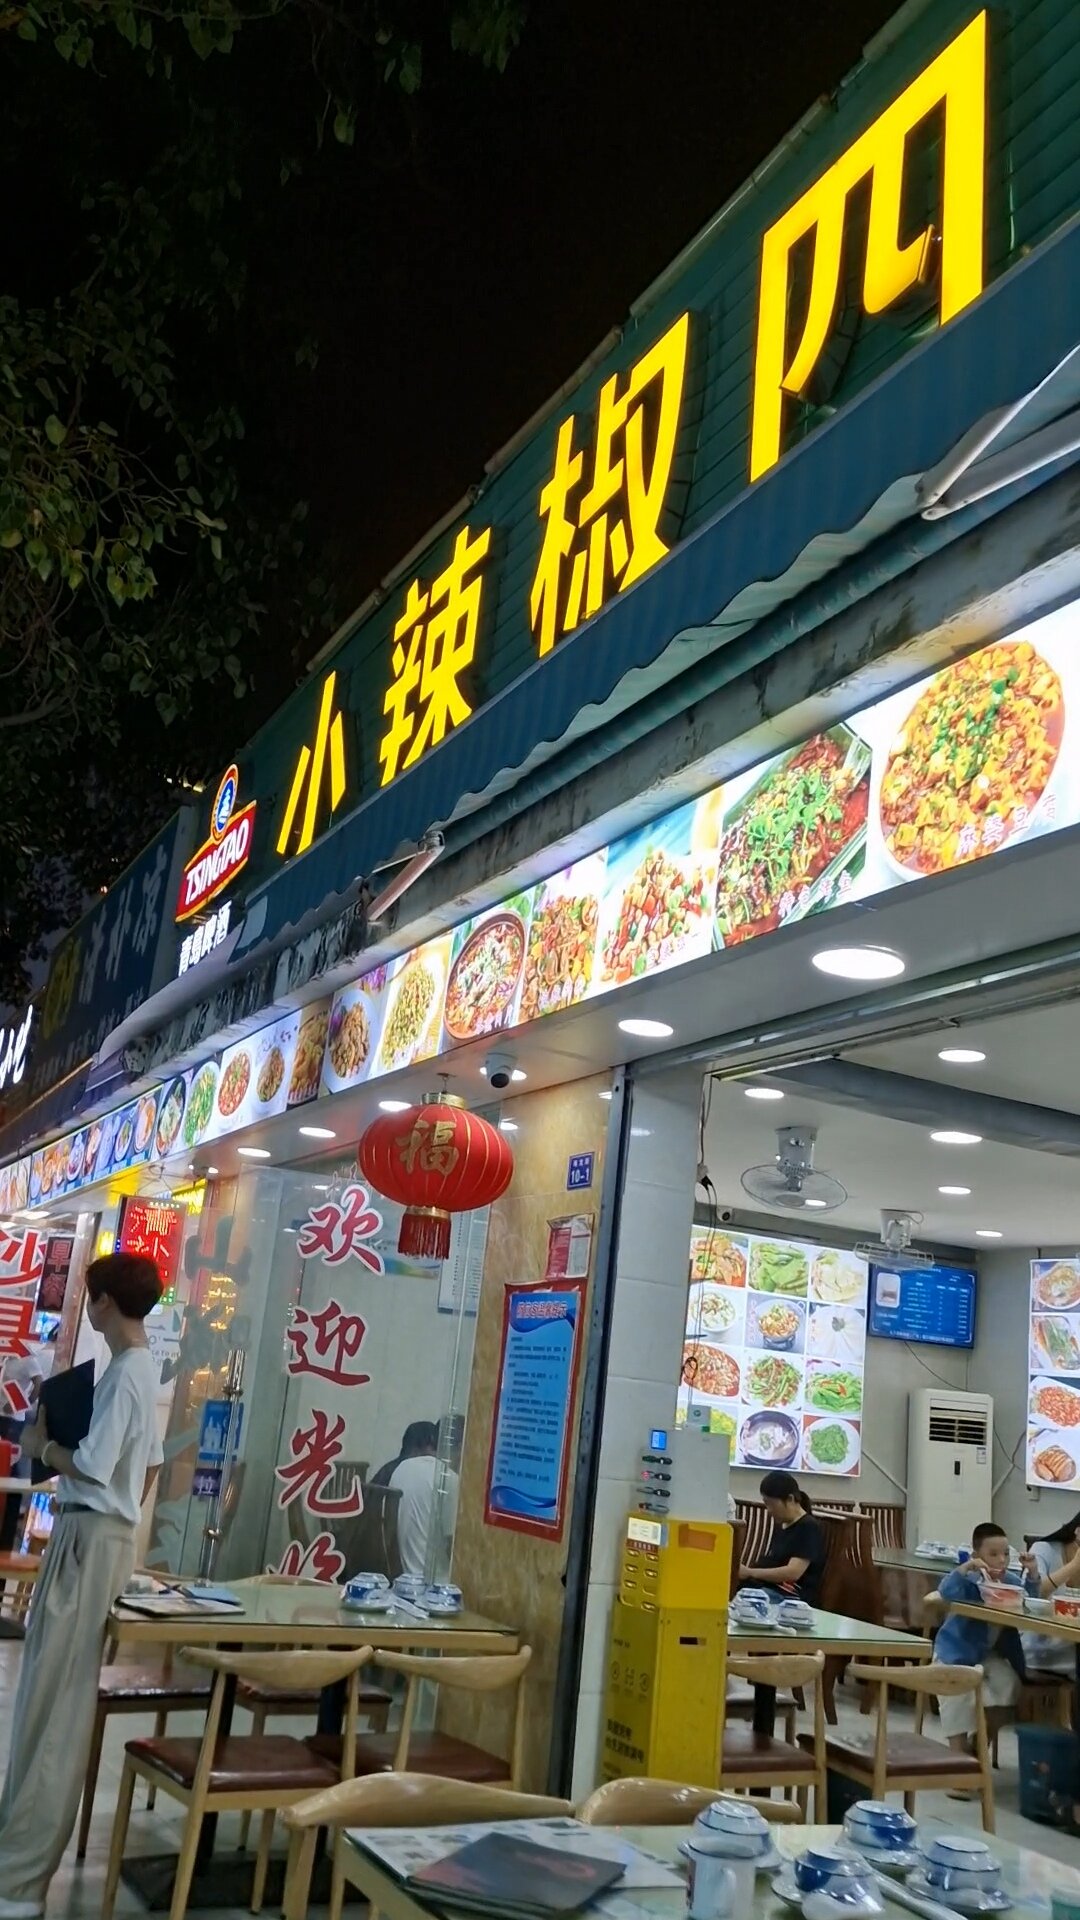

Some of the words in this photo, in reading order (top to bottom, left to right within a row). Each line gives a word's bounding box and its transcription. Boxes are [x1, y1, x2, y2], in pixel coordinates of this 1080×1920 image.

[185, 818, 250, 905] TSINGTAO
[395, 1120, 460, 1175] 福
[571, 1168, 590, 1184] 10-1
[198, 1475, 215, 1495] 拉
